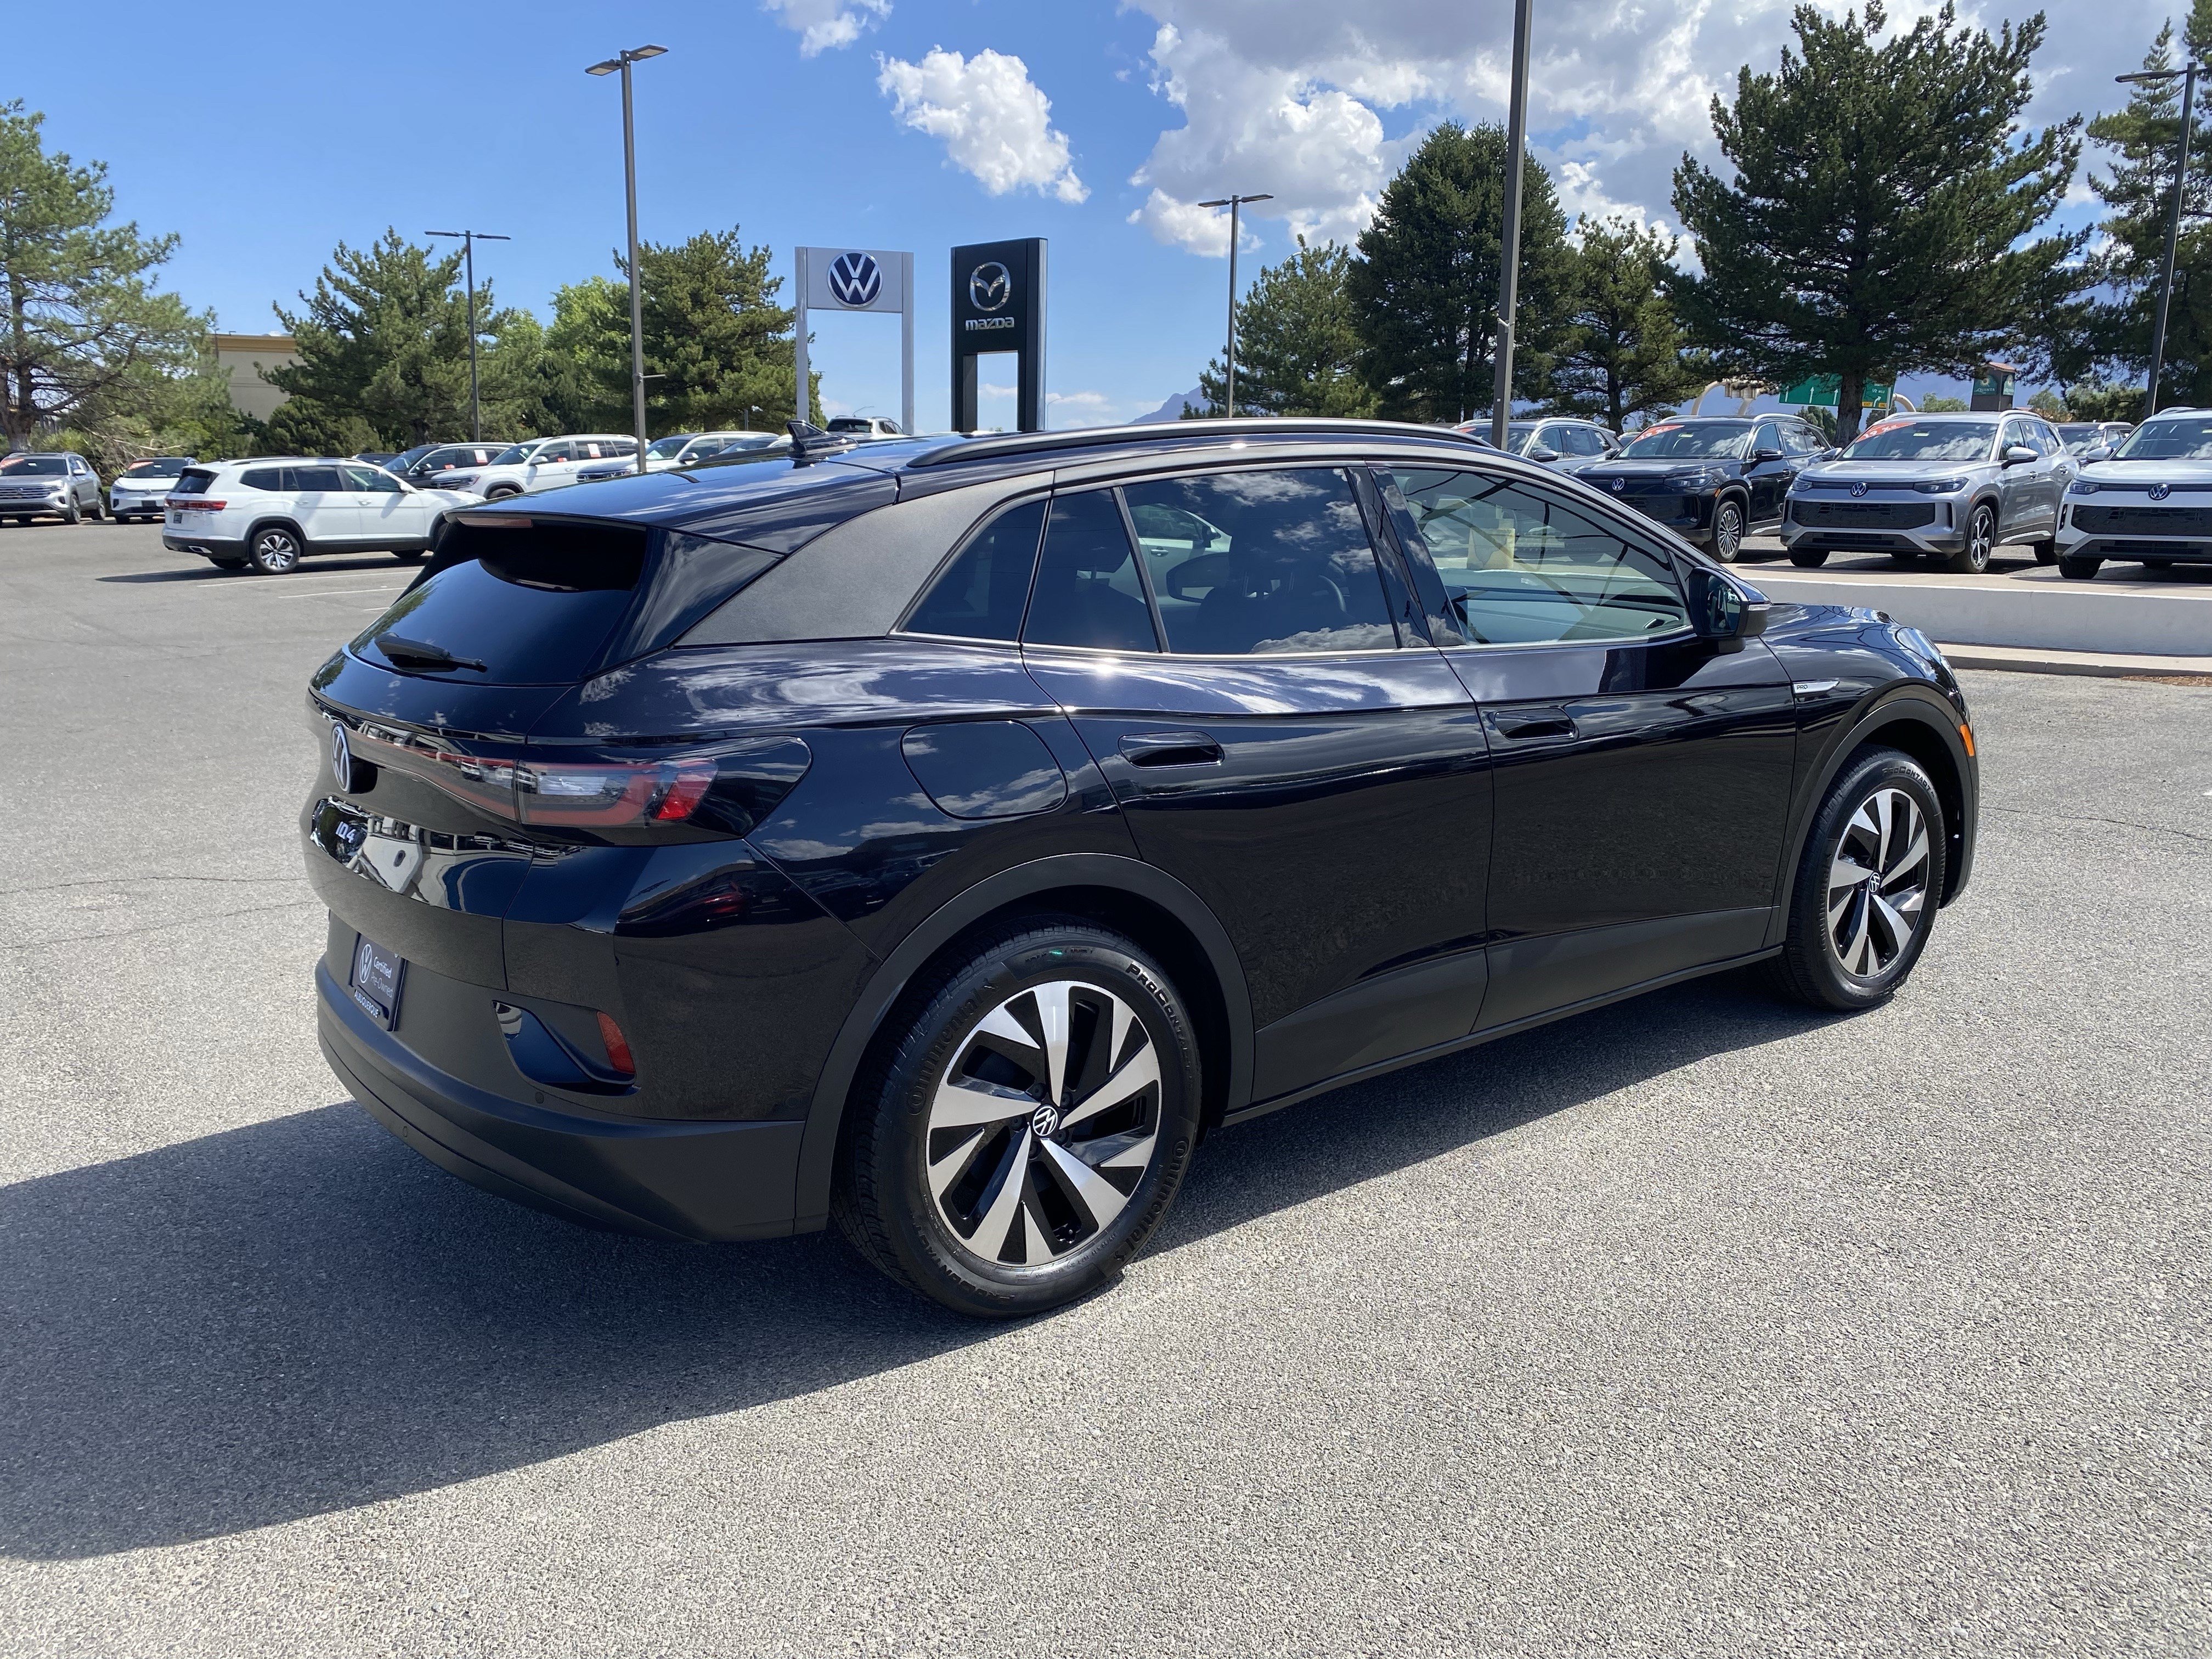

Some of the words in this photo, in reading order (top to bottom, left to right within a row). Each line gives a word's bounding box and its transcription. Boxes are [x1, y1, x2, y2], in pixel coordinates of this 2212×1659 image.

[828, 251, 882, 307] VW
[966, 317, 1015, 331] mazda
[374, 956, 392, 979] Certified
[369, 972, 393, 998] Pre-Owned
[354, 989, 379, 1018] ALBUQUERQUE
